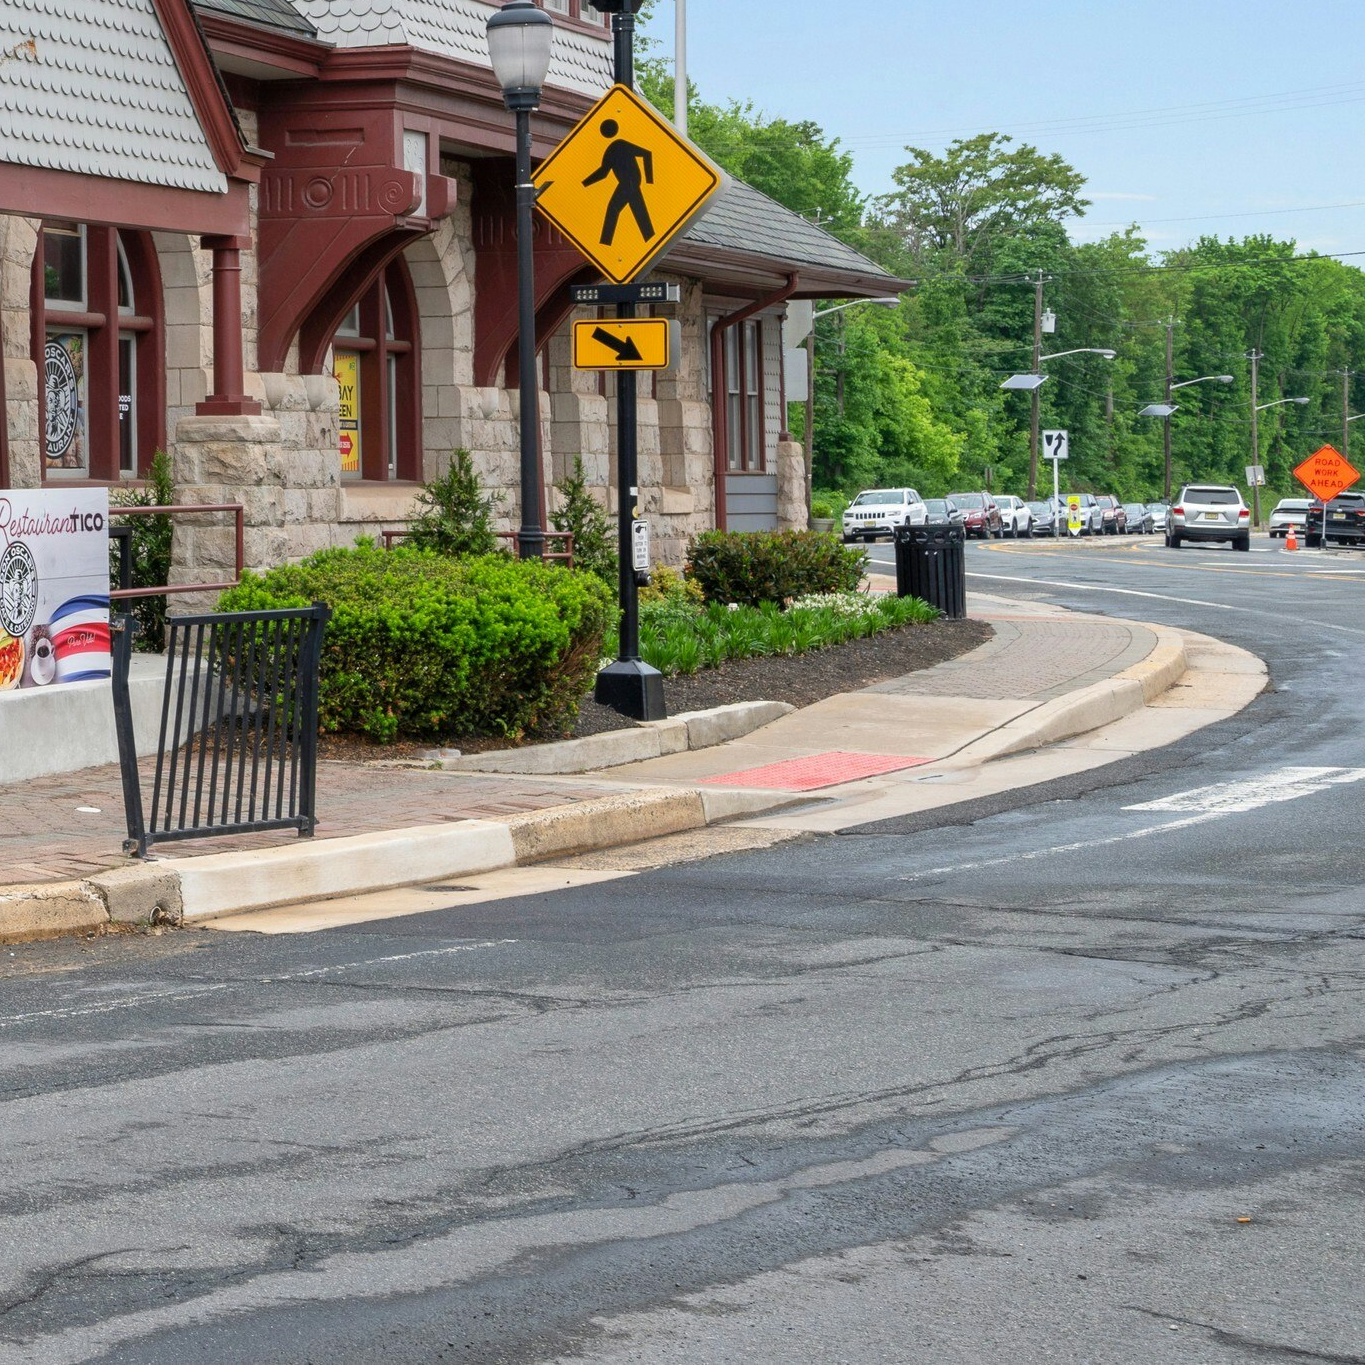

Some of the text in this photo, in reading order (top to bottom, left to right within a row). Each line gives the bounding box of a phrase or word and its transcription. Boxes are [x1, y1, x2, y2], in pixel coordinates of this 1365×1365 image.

[46, 414, 75, 452] AURANT
[1311, 479, 1343, 487] AHEAD
[70, 513, 103, 532] TICO
[0, 554, 11, 584] DON
